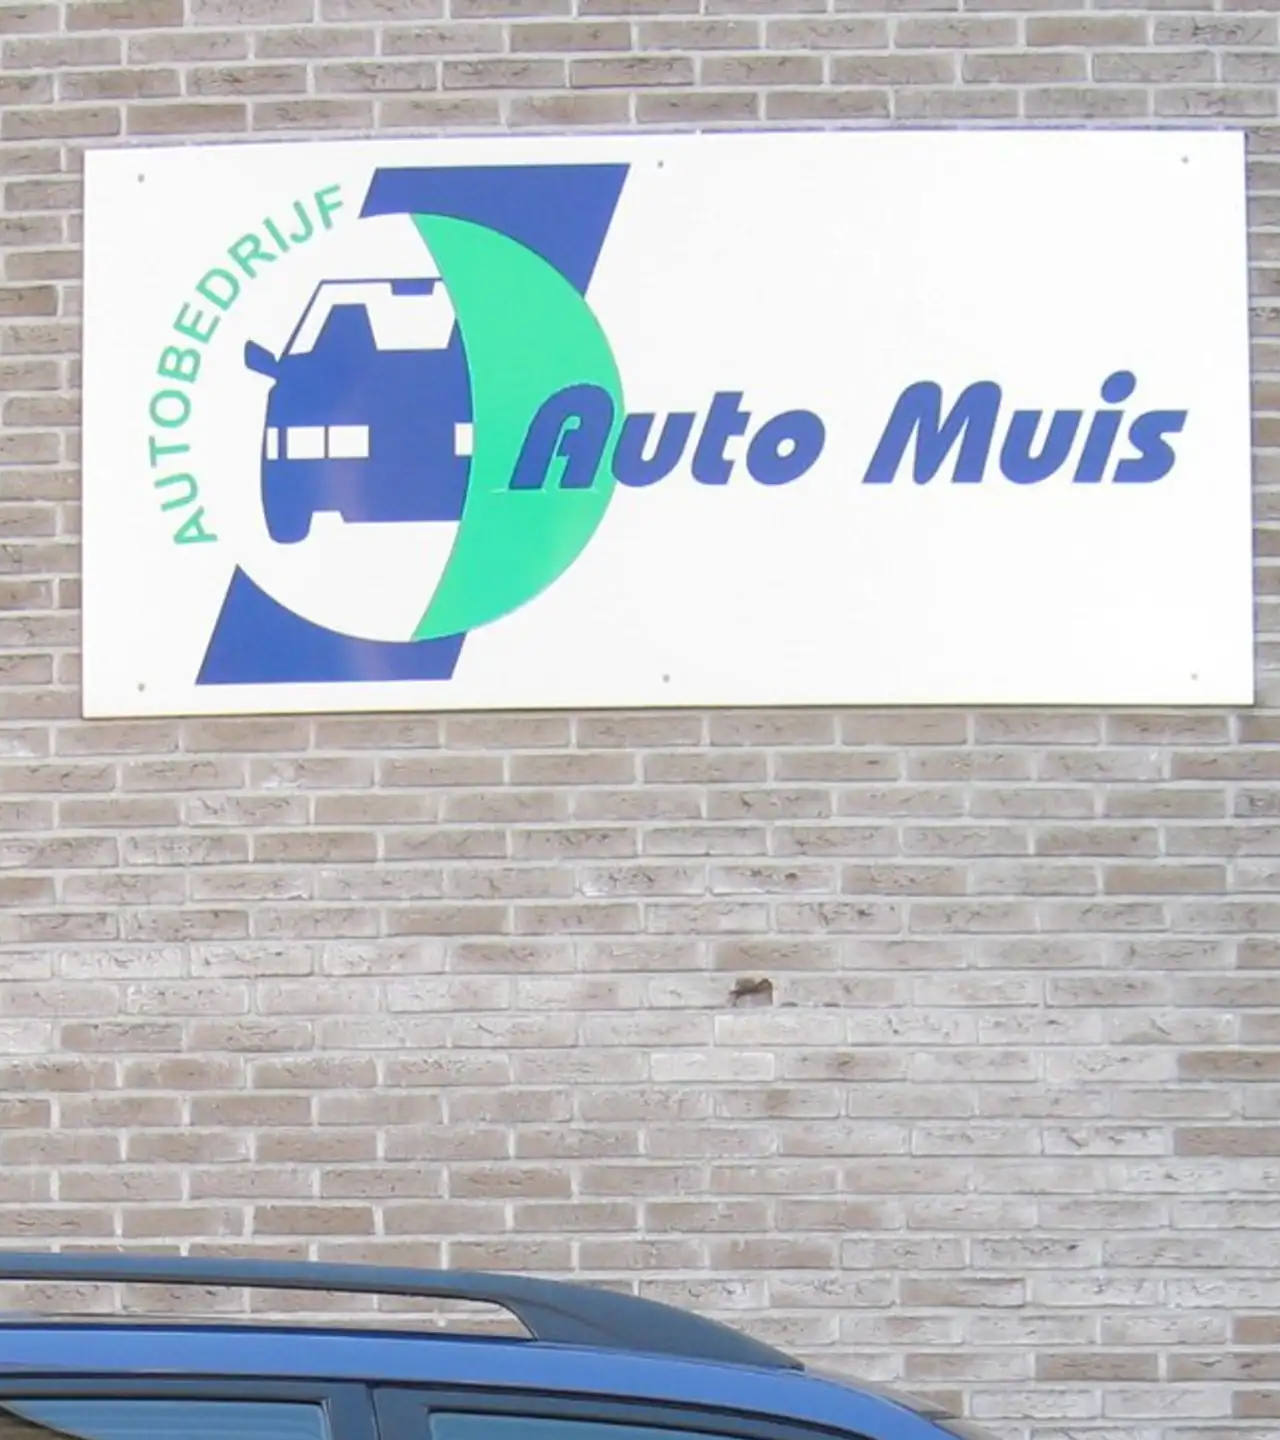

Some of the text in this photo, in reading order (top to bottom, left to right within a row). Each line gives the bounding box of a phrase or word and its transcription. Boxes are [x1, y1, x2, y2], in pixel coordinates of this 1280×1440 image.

[148, 184, 344, 545] AUTOBEDRIJF
[509, 370, 1188, 489] Auto Muis
